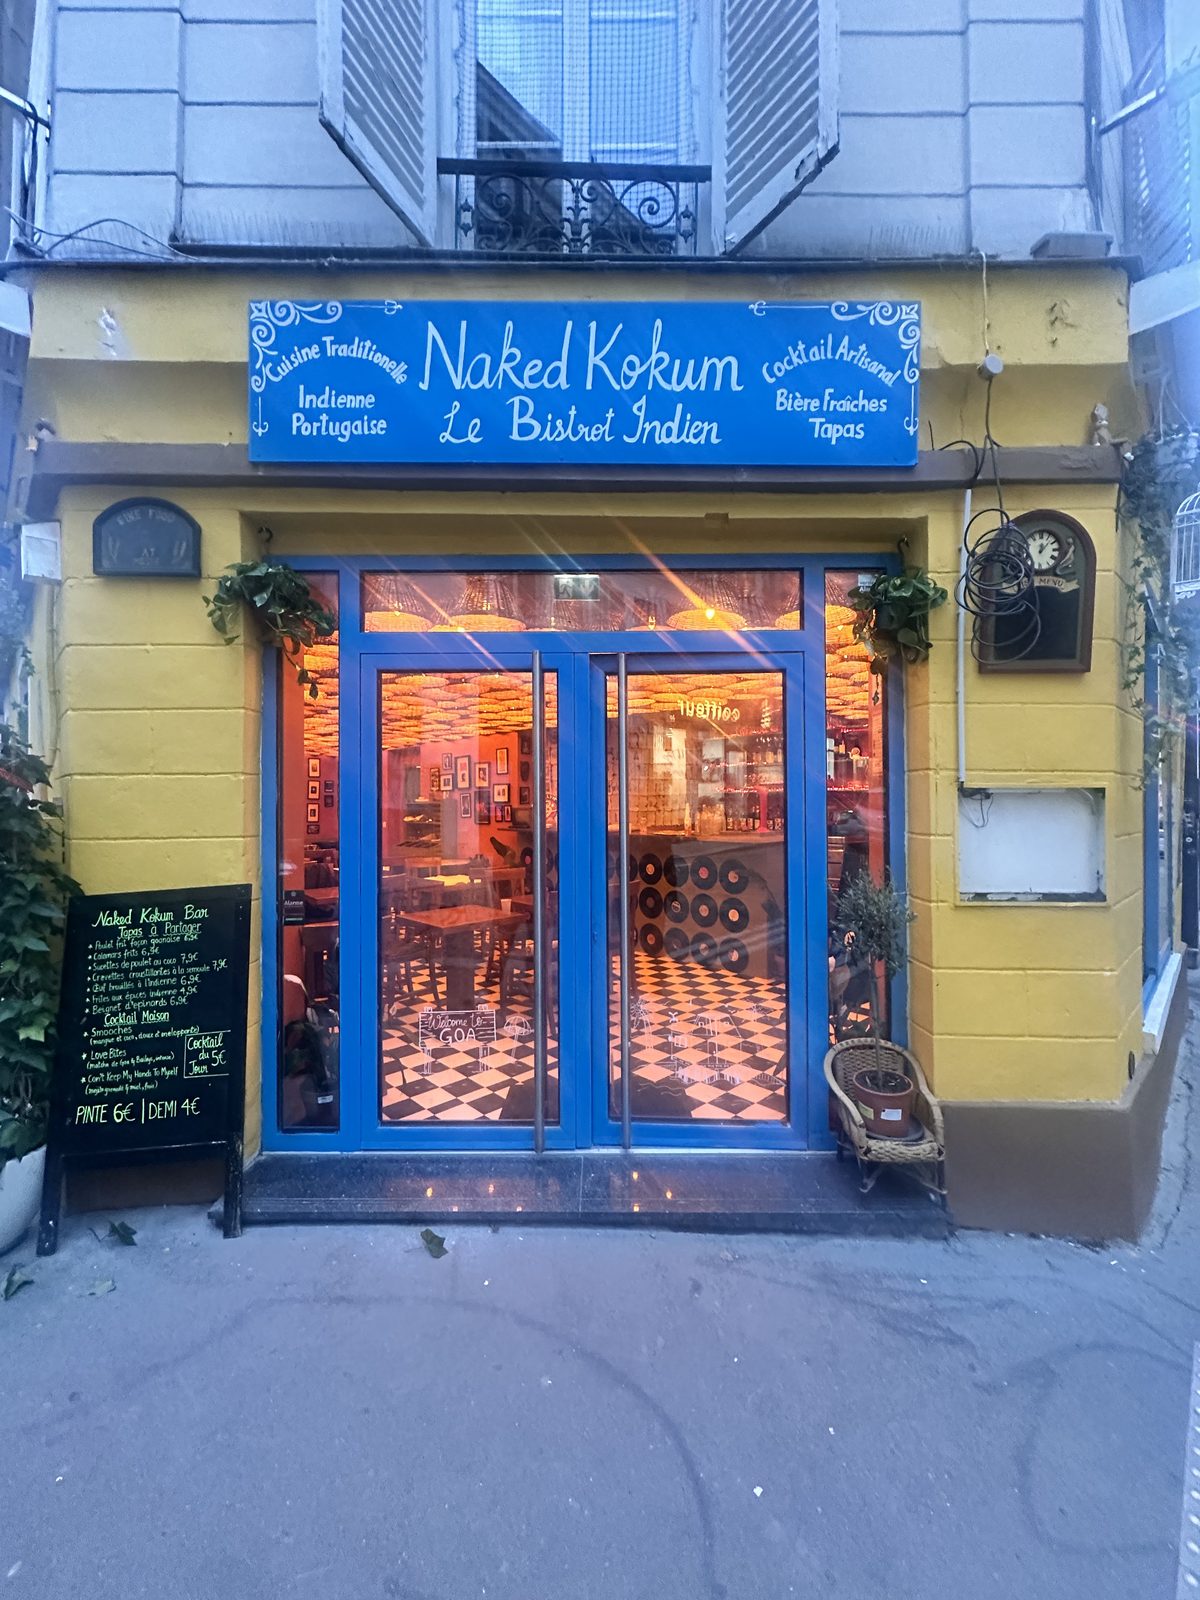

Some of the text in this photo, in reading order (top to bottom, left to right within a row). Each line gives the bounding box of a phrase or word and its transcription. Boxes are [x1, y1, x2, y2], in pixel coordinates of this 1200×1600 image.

[265, 335, 409, 385] Cuisine Traditionelle
[418, 318, 745, 392] Naked Kokum
[762, 333, 902, 388] Cocktail Artisanal
[298, 384, 376, 409] Indienne
[775, 388, 888, 412] Bière Fraîches
[291, 412, 387, 443] Portugaise
[439, 394, 723, 445] Le Bistrot Indien
[808, 417, 865, 445] Tapas
[1039, 578, 1064, 588] MENU
[91, 904, 209, 928] Naked Kokum Bar
[117, 926, 143, 941] Tapas
[164, 921, 202, 937] Partager
[120, 959, 130, 969] de
[130, 957, 152, 971] poulet
[163, 957, 177, 965] coco
[180, 951, 199, 964] 7,9€
[123, 948, 139, 960] frits
[92, 972, 125, 982] Crevettes
[177, 965, 185, 975] la
[211, 958, 229, 972] 7,9€
[180, 973, 202, 986] 6,9€
[180, 985, 199, 996] 4,9€
[169, 995, 189, 1006] 6,9€
[103, 1010, 170, 1027] Cocktail Maison
[428, 1014, 468, 1030] Welcome
[91, 1025, 133, 1038] Smooches
[439, 1028, 477, 1044] GOA
[187, 1032, 224, 1051] Cocktail
[90, 1047, 127, 1060] Love Bites
[198, 1049, 227, 1067] du 5€
[87, 1072, 105, 1083] Can't
[106, 1071, 122, 1082] Keep
[122, 1069, 133, 1083] My
[134, 1069, 152, 1078] Hands
[152, 1067, 160, 1076] To
[188, 1059, 209, 1076] Jour
[74, 1104, 109, 1125] PINTE
[113, 1102, 136, 1123] 6€
[148, 1100, 177, 1120] DEMI
[180, 1097, 201, 1116] 4€
